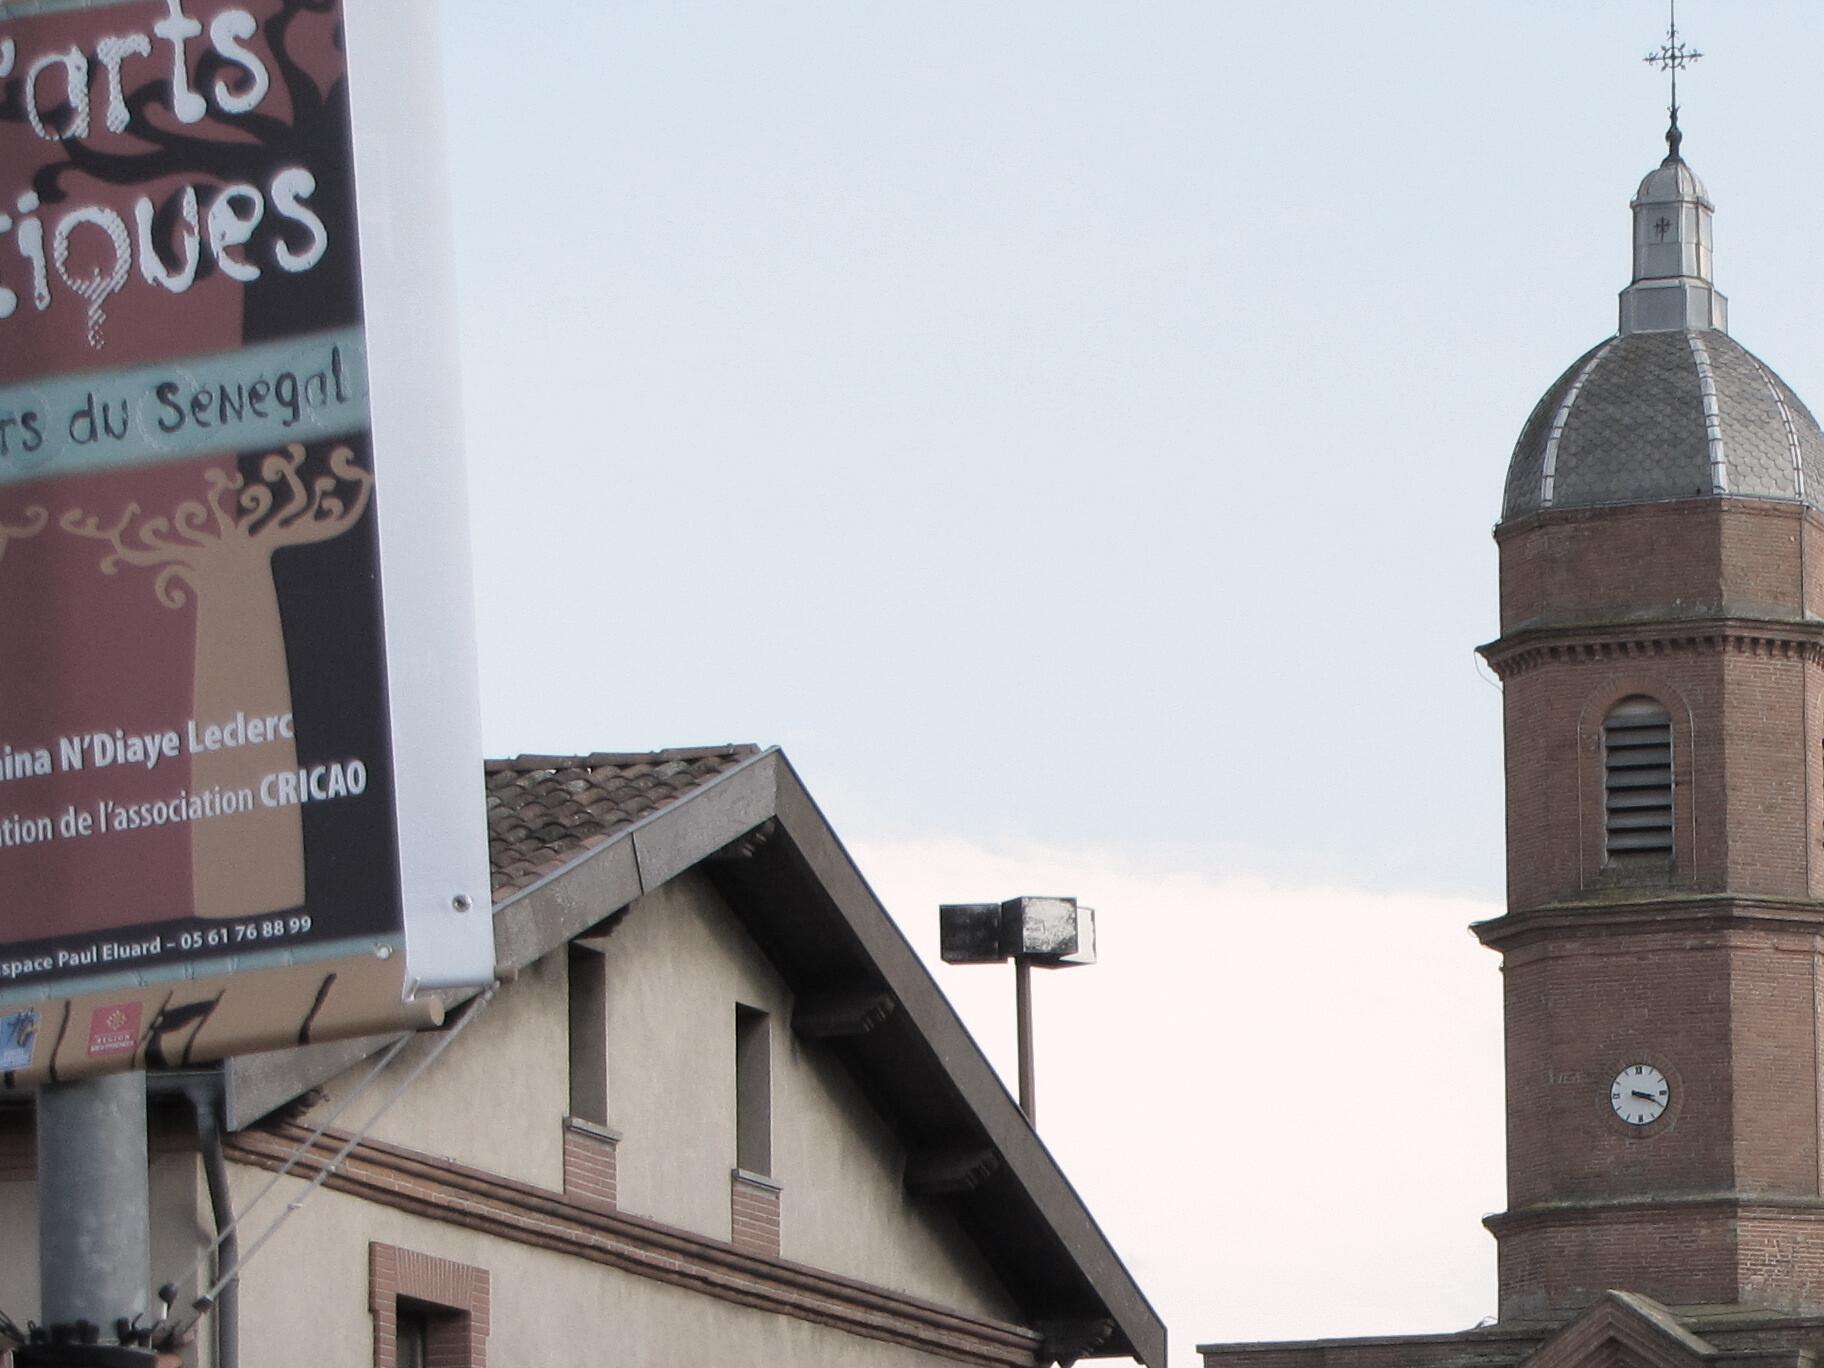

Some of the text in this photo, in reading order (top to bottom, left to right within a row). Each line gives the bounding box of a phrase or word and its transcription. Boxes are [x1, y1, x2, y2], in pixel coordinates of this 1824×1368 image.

[69, 392, 129, 445] du
[0, 710, 294, 783] ina N'Diaye Leclerc
[0, 759, 368, 848] tion de l'association CRICAO
[0, 956, 54, 979] space
[58, 944, 98, 970] Paul
[102, 936, 161, 963] Eluard
[181, 931, 203, 951] 05
[207, 926, 230, 946] 61
[234, 922, 258, 943] 76
[262, 919, 285, 938] 88
[289, 915, 313, 933] 99
